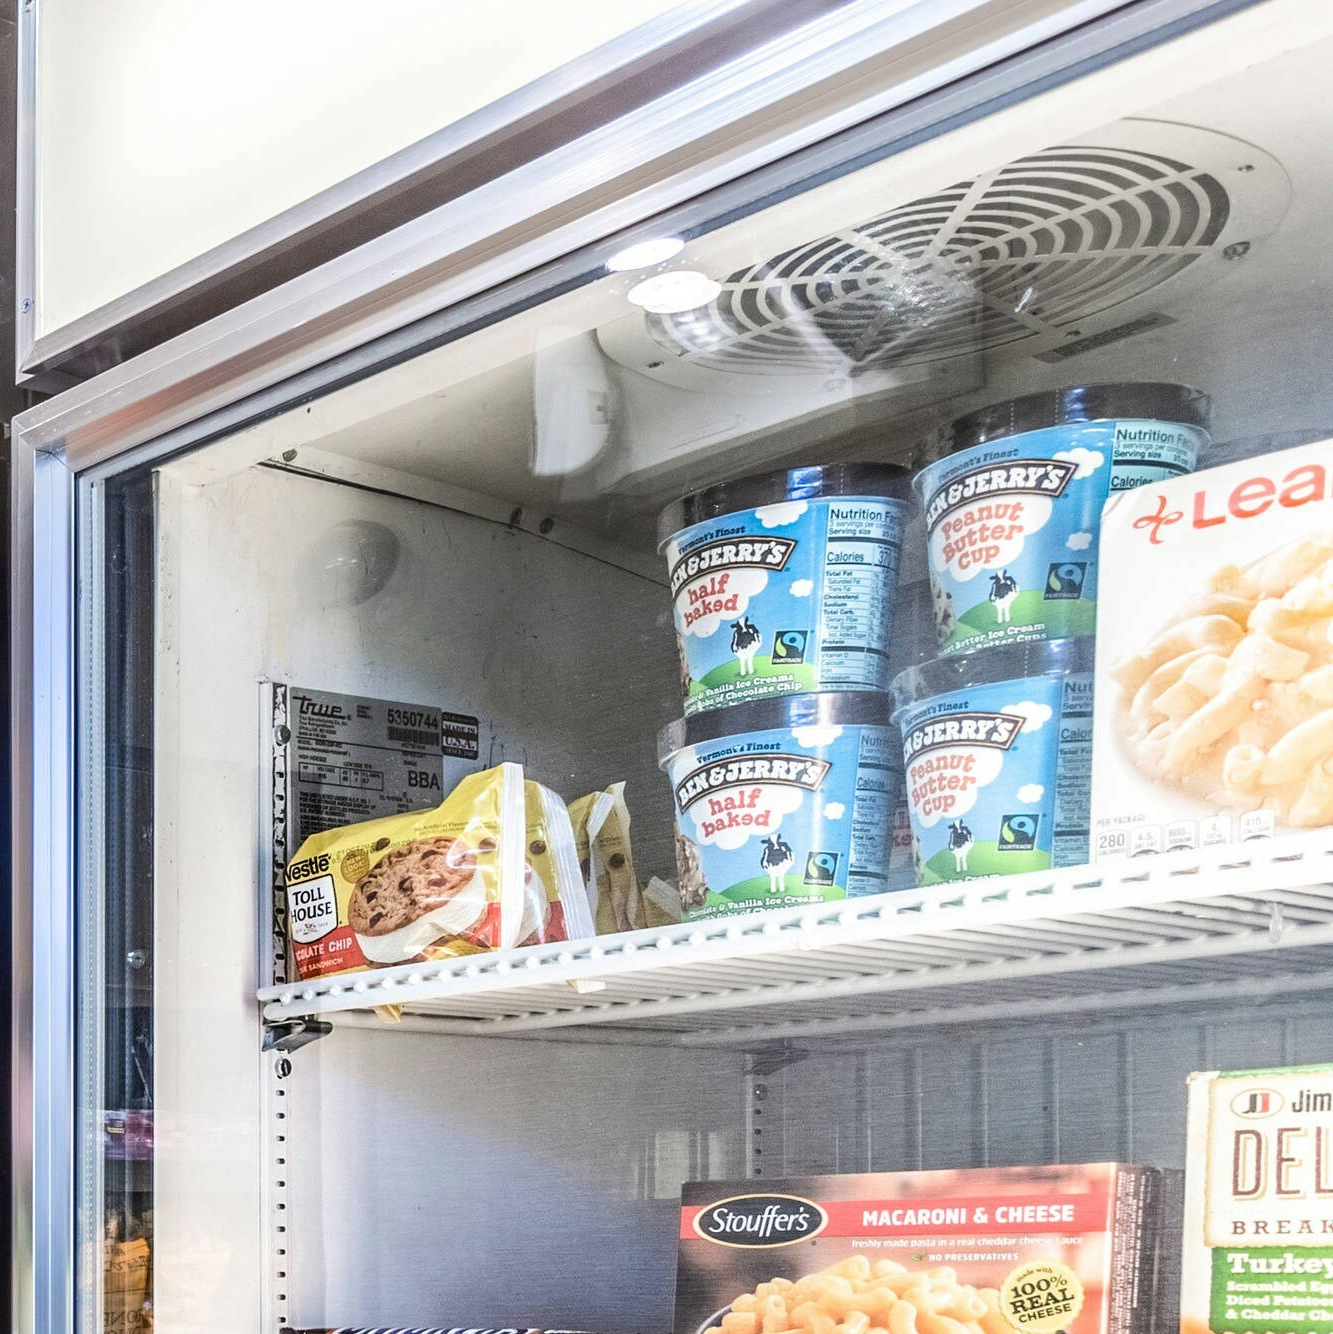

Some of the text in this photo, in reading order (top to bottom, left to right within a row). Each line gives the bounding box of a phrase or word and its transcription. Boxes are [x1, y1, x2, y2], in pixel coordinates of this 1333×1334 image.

[1193, 464, 1333, 531] Lea
[831, 509, 882, 520] Nutrition
[940, 502, 1024, 542] Peanut
[700, 542, 787, 566] JERRY'S
[943, 522, 1024, 565] Butter
[958, 545, 1001, 570] Cup
[687, 573, 730, 605] half
[684, 595, 738, 628] baked
[293, 695, 347, 719] true
[387, 708, 438, 729] 5350744
[408, 770, 440, 790] BBA
[293, 888, 325, 905] TOLL
[708, 1205, 810, 1236] Stouffer's
[862, 1205, 1075, 1227] MACARONI & CHEESE
[852, 1239, 880, 1248] freshly
[882, 1239, 908, 1247] made
[911, 1239, 936, 1248] pasta
[977, 1237, 1015, 1246] cheddar
[929, 1252, 1019, 1262] NO PRESERVATIVES
[1009, 1288, 1075, 1314] REAL
[1018, 1303, 1072, 1325] CHEESE
